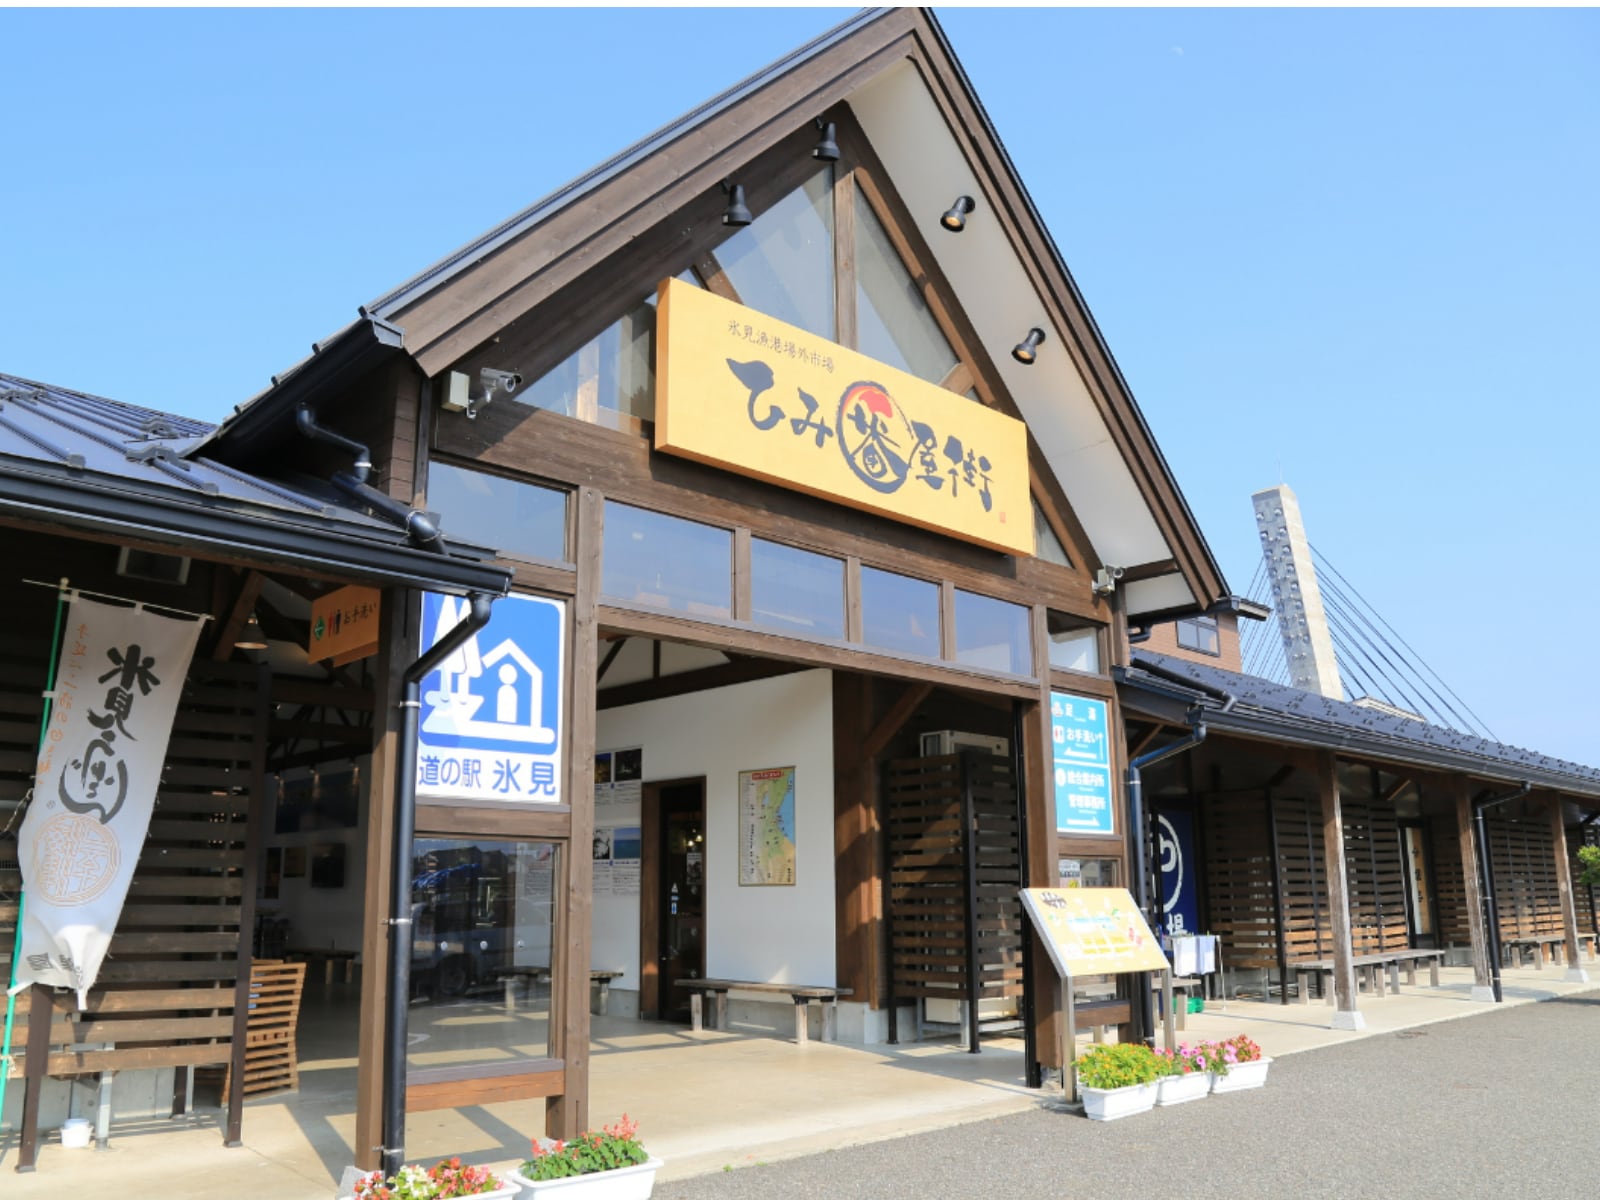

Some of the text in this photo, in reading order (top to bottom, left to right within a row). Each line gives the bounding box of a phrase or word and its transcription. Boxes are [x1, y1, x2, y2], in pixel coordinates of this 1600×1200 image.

[728, 320, 834, 374] 氷見漁港場外市場
[726, 357, 993, 512] ひみ番屋街
[418, 755, 481, 789] 道の駅
[492, 758, 556, 796] 氷見
